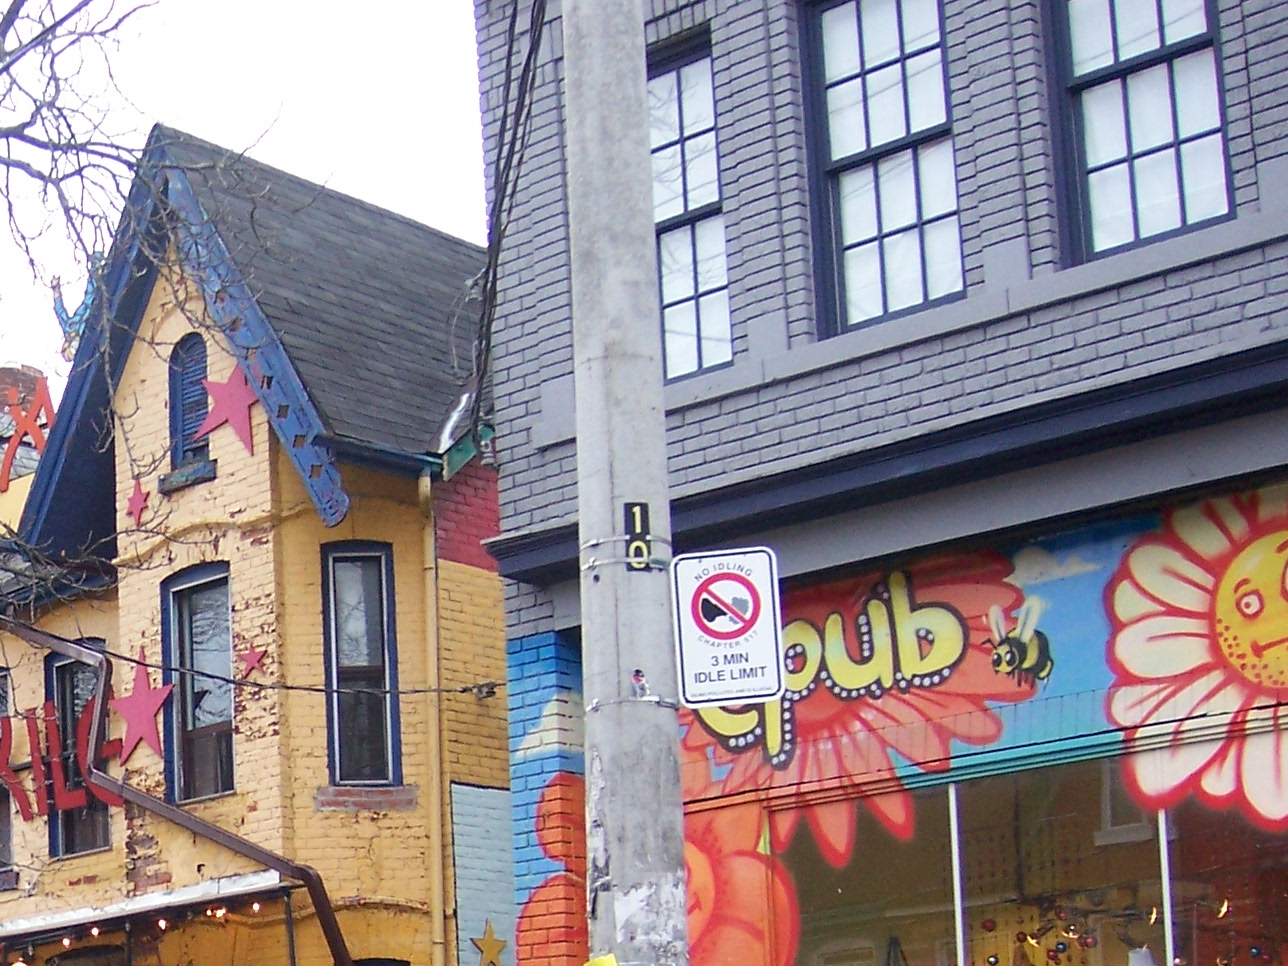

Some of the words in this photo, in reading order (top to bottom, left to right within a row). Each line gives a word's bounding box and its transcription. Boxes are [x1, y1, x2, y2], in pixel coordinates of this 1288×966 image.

[694, 567, 710, 583] NO
[713, 562, 753, 578] IDLING
[698, 633, 740, 650] CHAPTER
[711, 655, 720, 667] 3
[724, 651, 749, 666] MIN
[694, 670, 726, 684] IDLE
[730, 665, 768, 681] LIMIT
